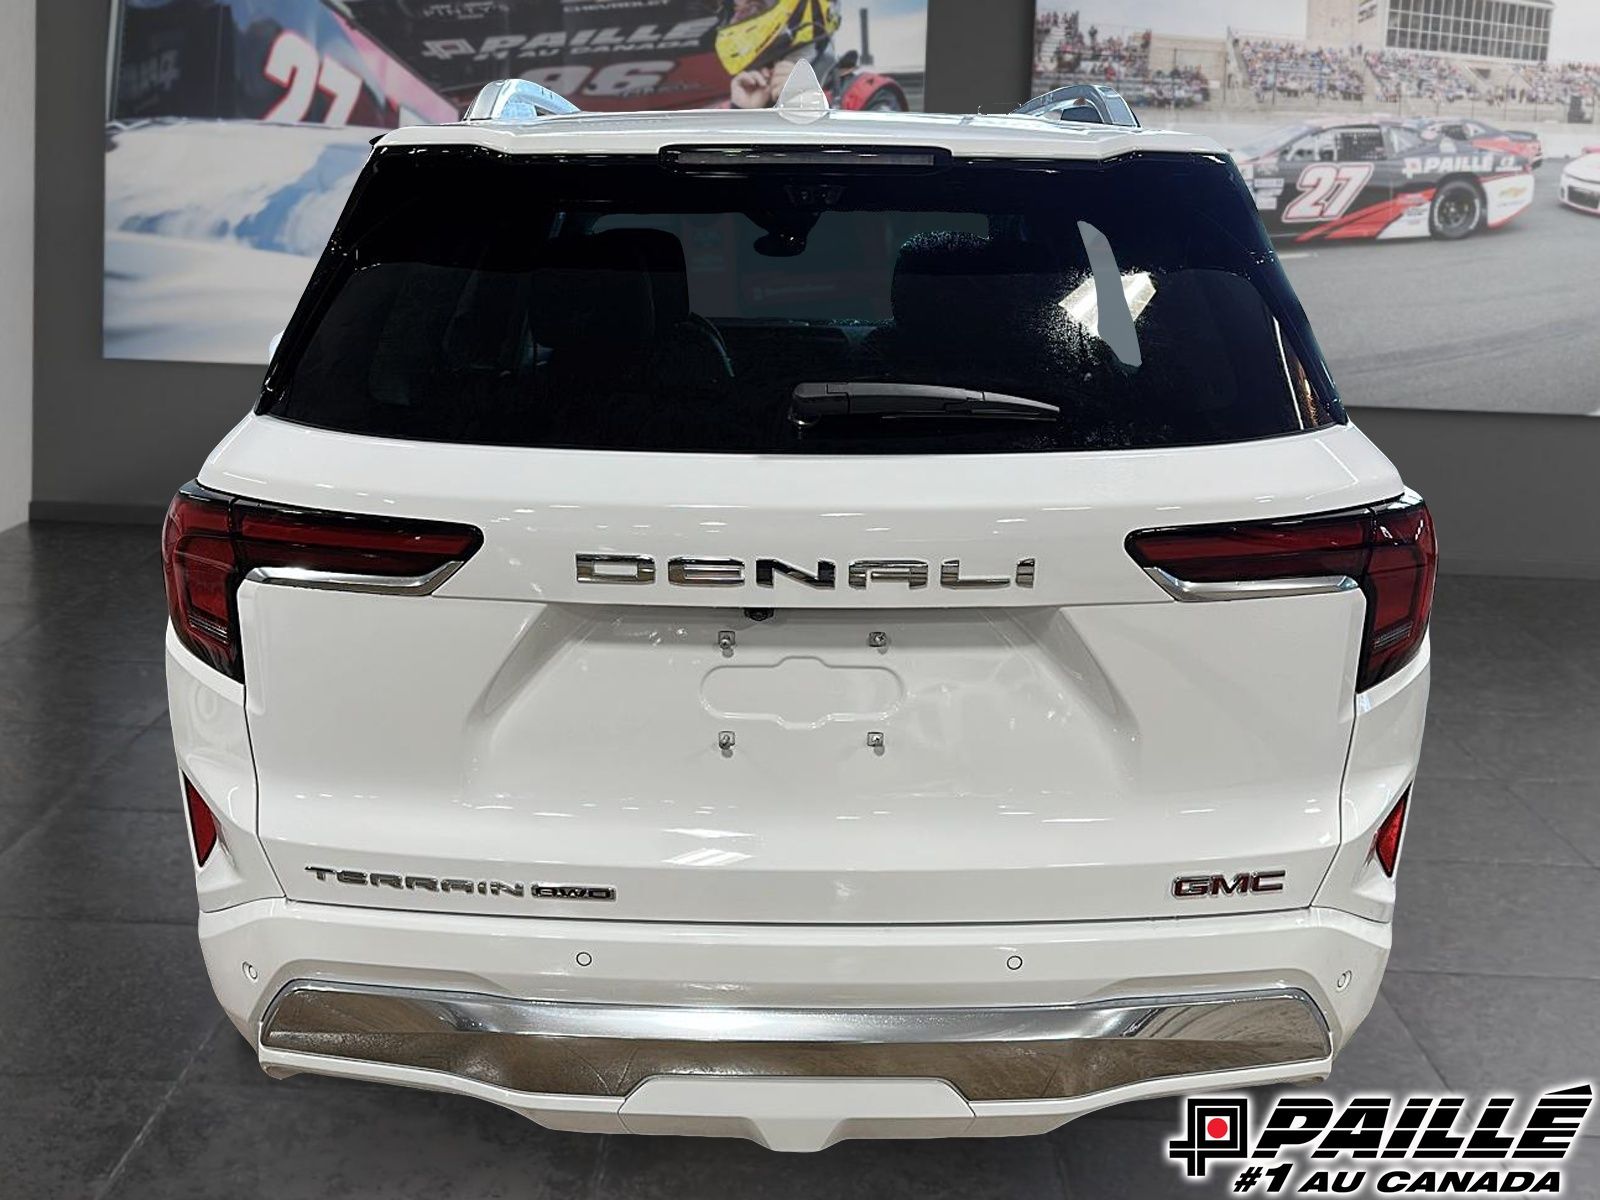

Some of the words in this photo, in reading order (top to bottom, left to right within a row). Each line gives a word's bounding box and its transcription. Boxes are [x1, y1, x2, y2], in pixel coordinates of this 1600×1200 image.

[264, 29, 363, 128] 27
[1281, 162, 1375, 223] 27
[575, 552, 1036, 590] DENALI
[304, 865, 524, 898] TERRAIN
[1172, 869, 1286, 899] GMC
